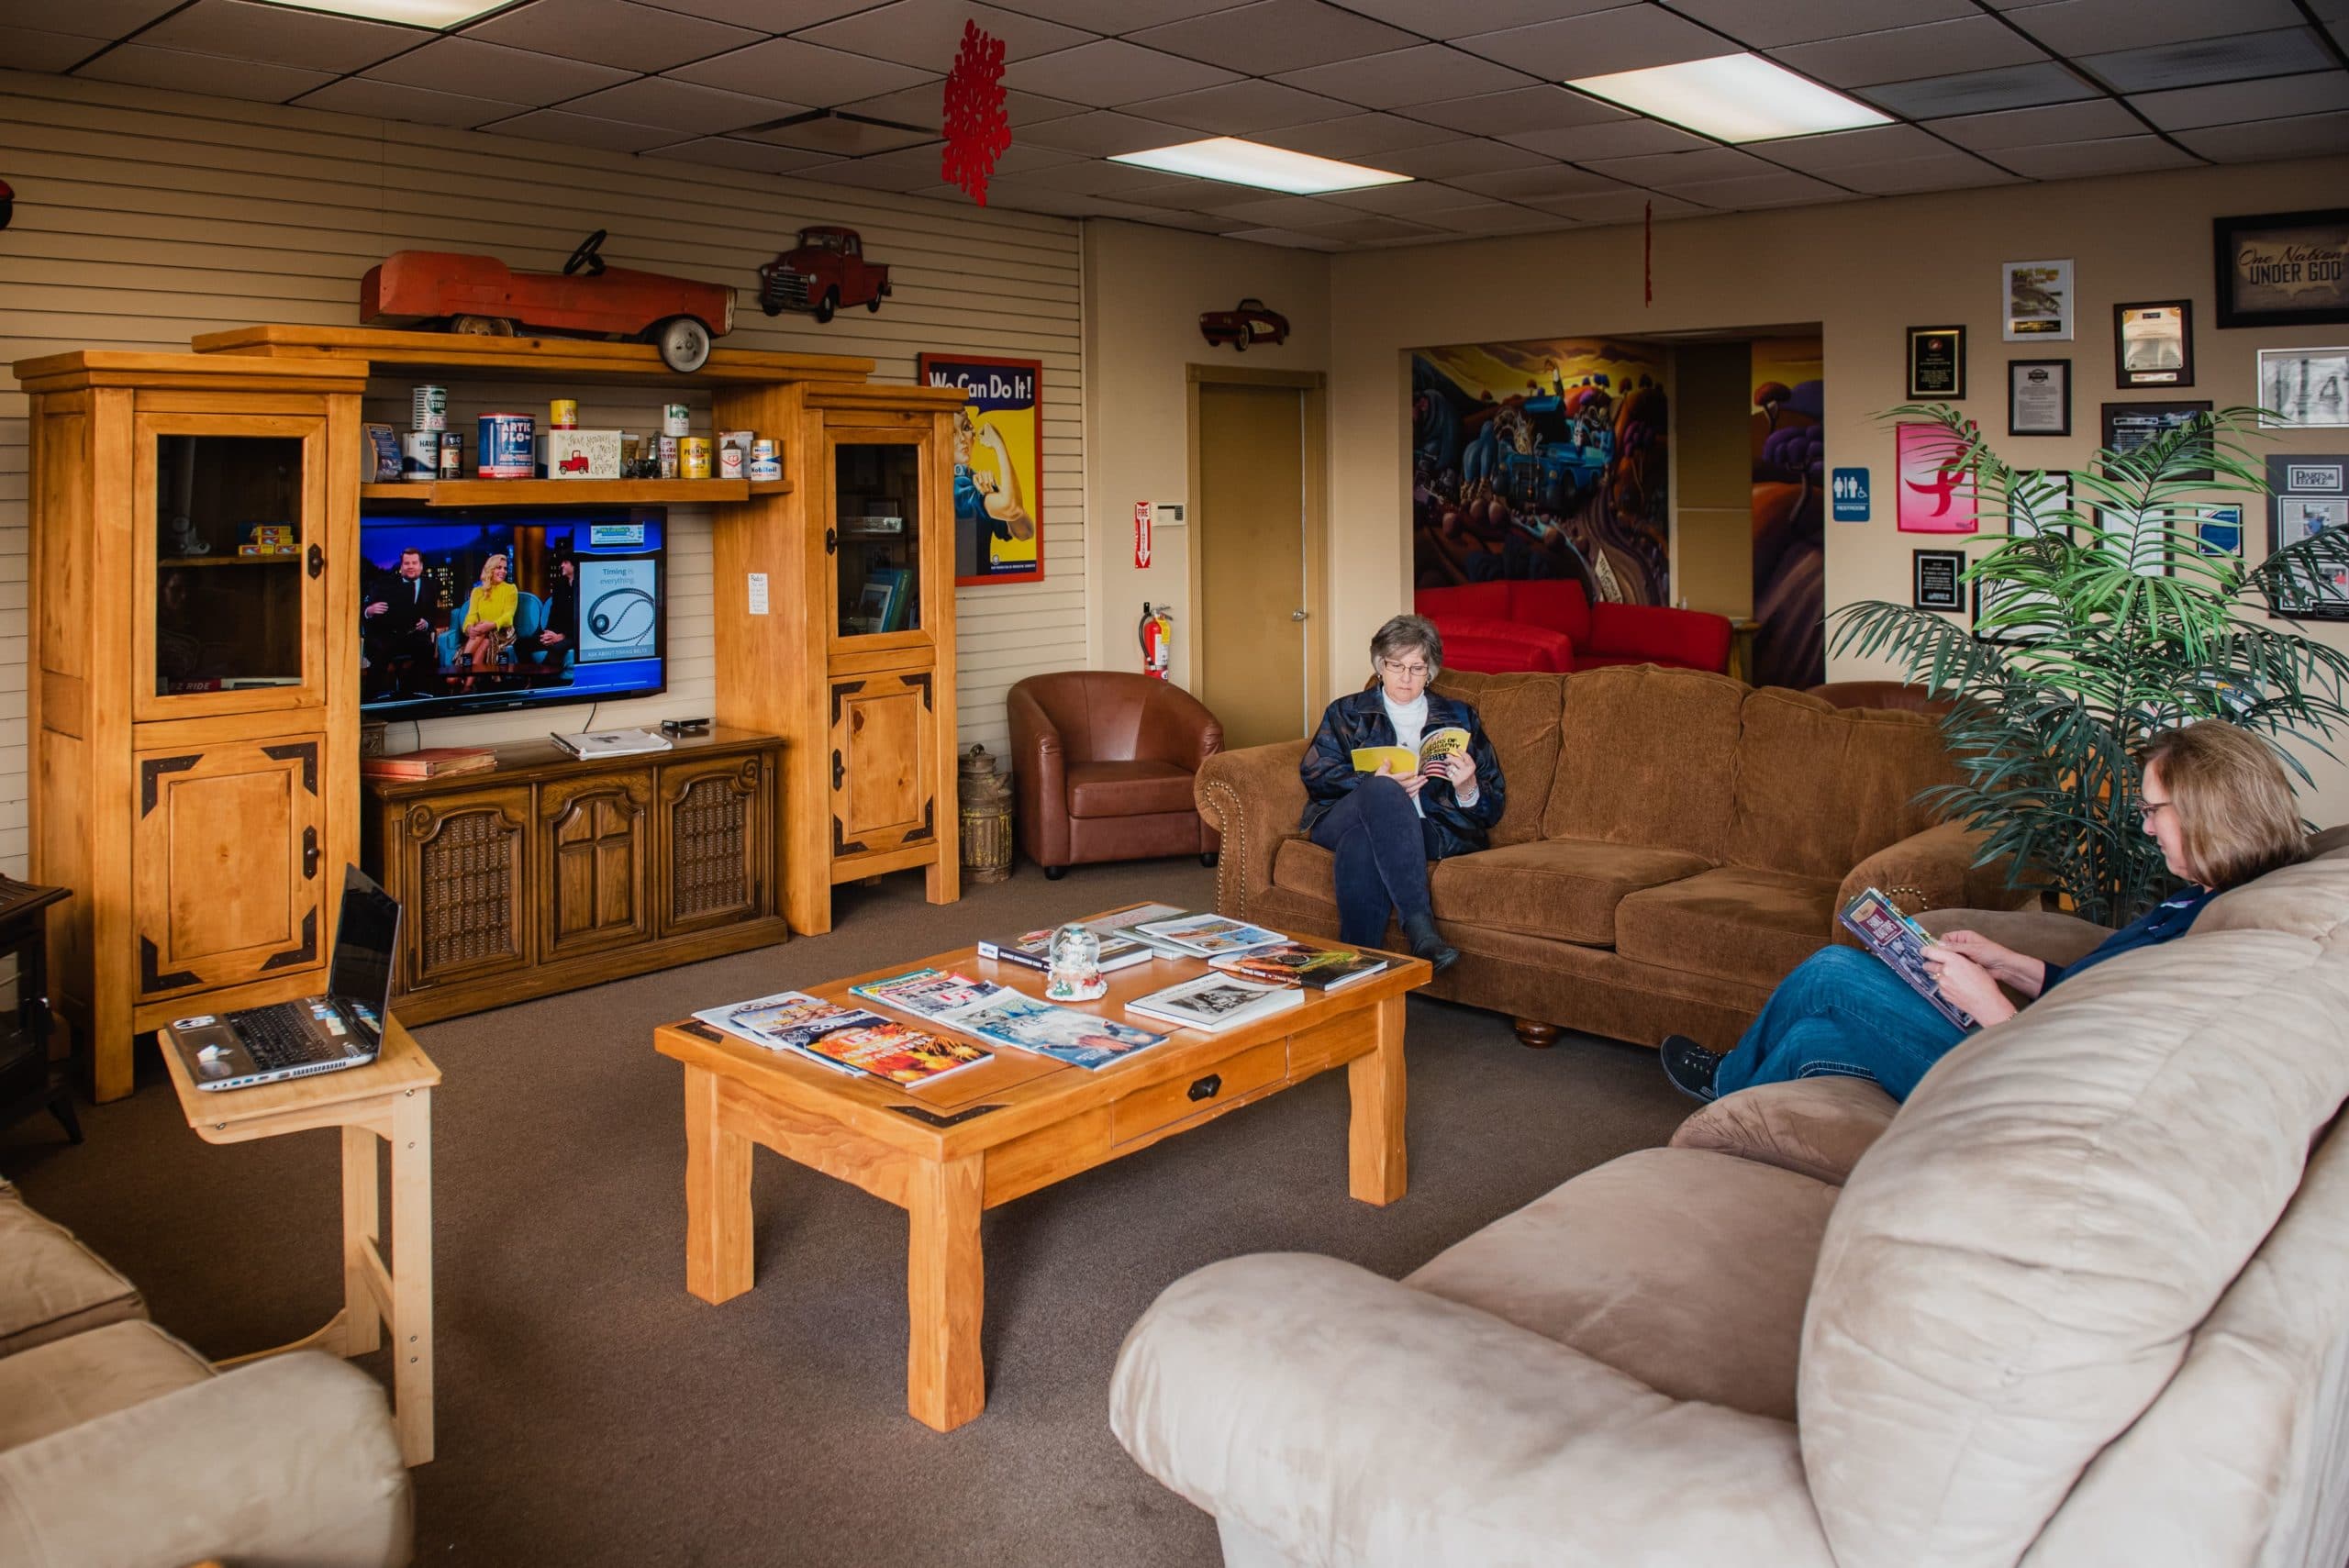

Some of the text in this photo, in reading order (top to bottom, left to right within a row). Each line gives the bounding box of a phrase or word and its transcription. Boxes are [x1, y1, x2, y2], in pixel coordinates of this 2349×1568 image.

[2239, 243, 2343, 266] One Nation
[2250, 261, 2342, 285] UNDER GOD
[957, 373, 987, 398] Can
[990, 374, 1012, 398] Do
[1015, 375, 1032, 399] It!
[1138, 508, 1148, 517] FIRE
[603, 568, 627, 576] Timing
[185, 682, 211, 691] RIDE
